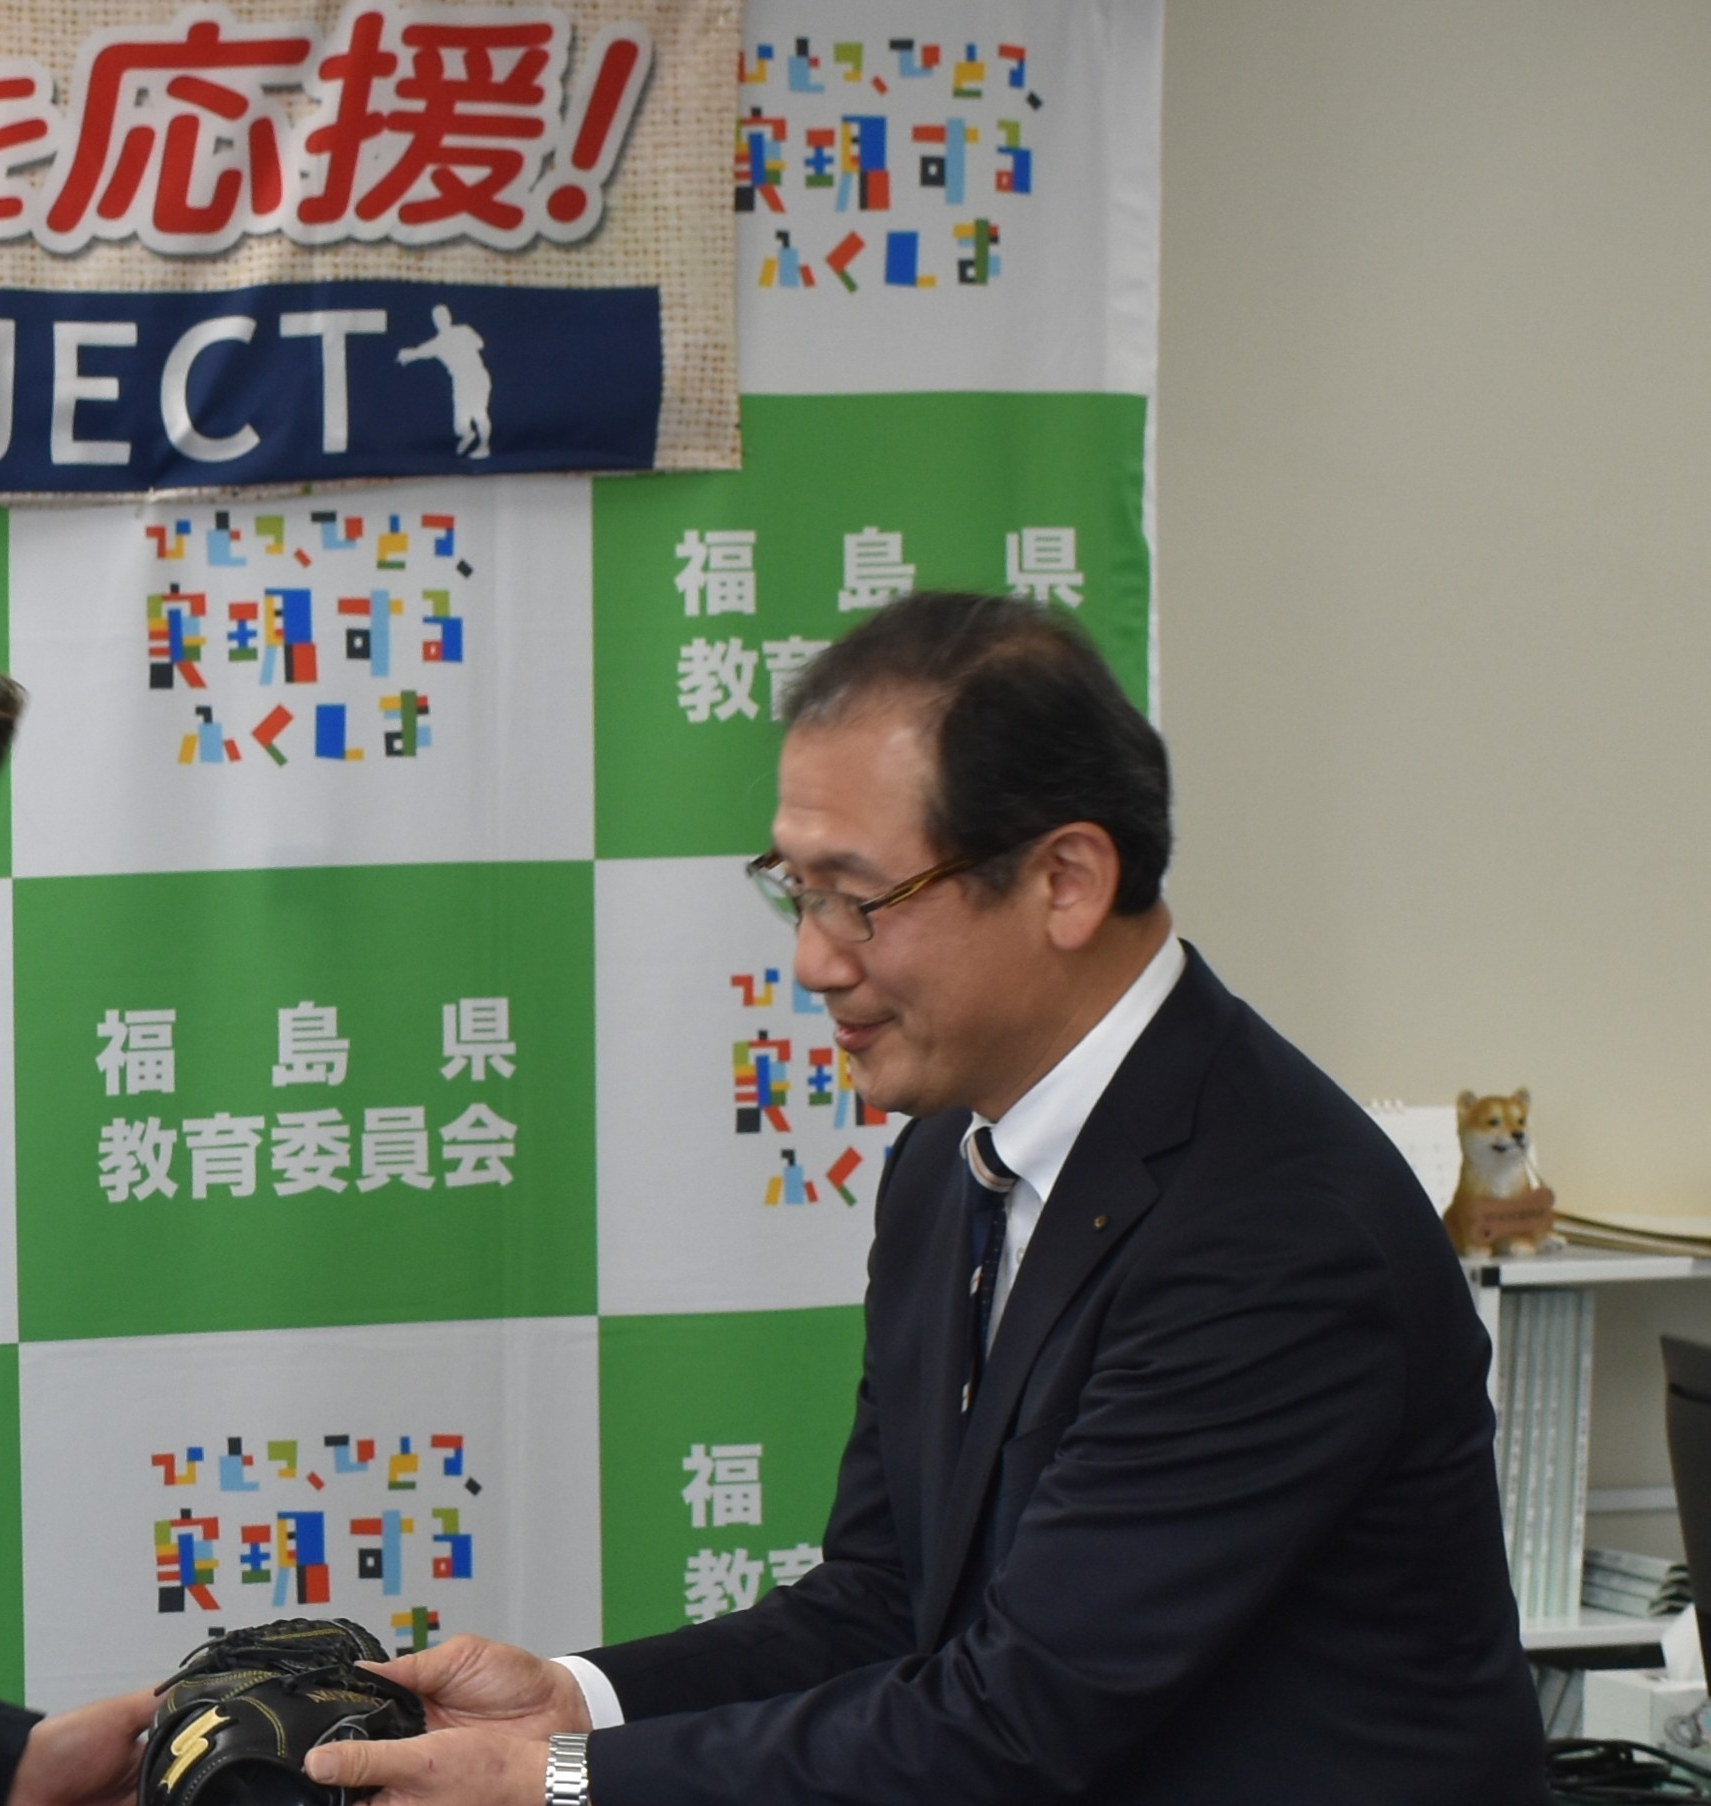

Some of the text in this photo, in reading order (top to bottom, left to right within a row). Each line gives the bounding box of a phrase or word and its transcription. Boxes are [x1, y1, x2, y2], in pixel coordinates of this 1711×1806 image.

[95, 997, 516, 1096] 福島県
[99, 1103, 517, 1203] 教育委員会
